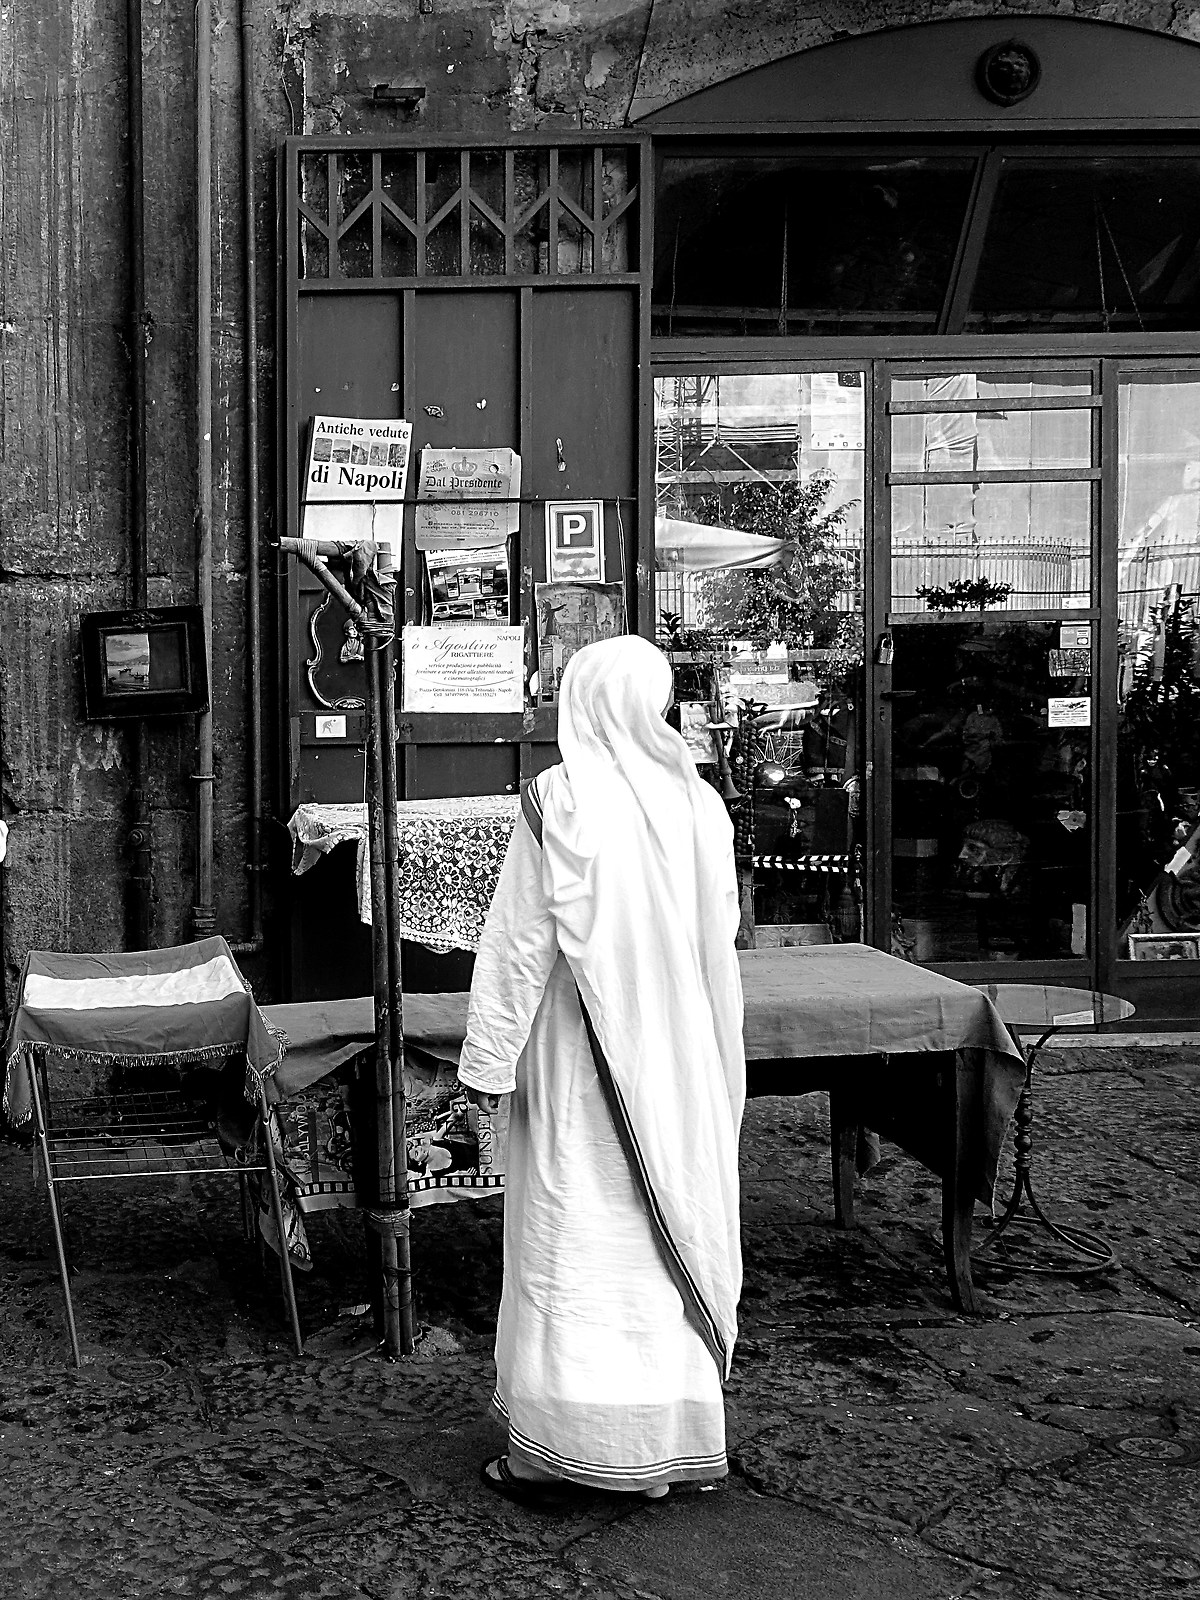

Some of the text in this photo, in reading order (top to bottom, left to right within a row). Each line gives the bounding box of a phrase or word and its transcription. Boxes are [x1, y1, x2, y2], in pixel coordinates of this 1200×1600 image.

[316, 421, 409, 440] Antiche vedute
[310, 464, 404, 493] di Napoli
[425, 475, 503, 489] Dal Presidente
[562, 514, 587, 545] P
[424, 635, 498, 662] Agostino
